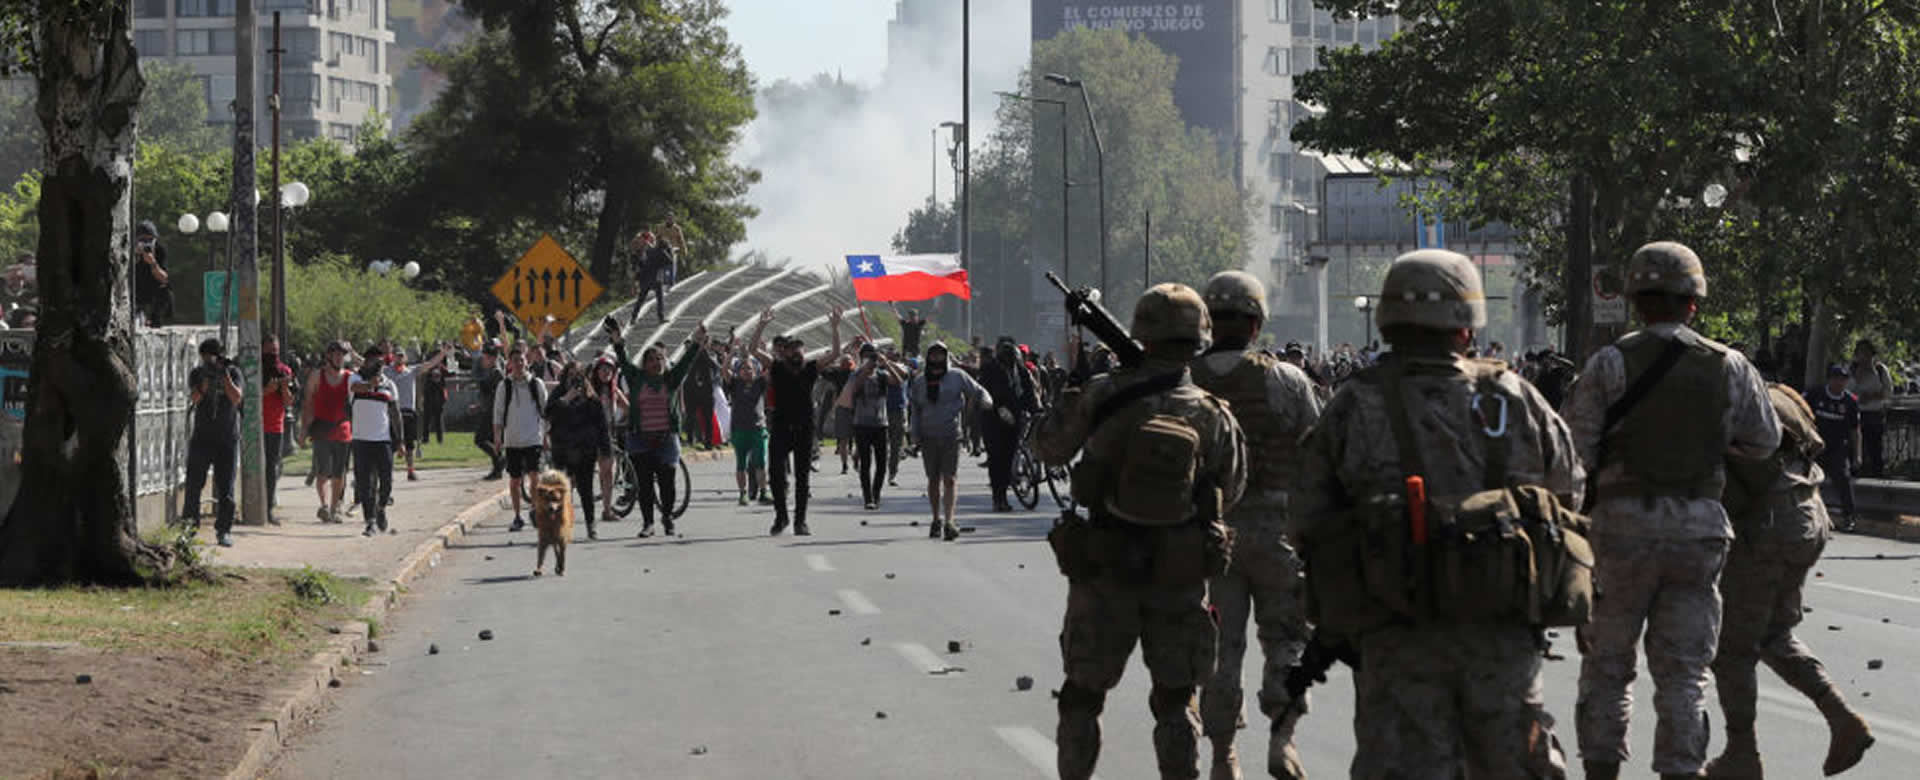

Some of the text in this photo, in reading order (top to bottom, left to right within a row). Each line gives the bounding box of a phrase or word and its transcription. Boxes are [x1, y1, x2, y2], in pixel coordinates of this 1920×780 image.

[1064, 5, 1204, 18] EL COMIENZO DE
[1150, 18, 1205, 31] JUEGO
